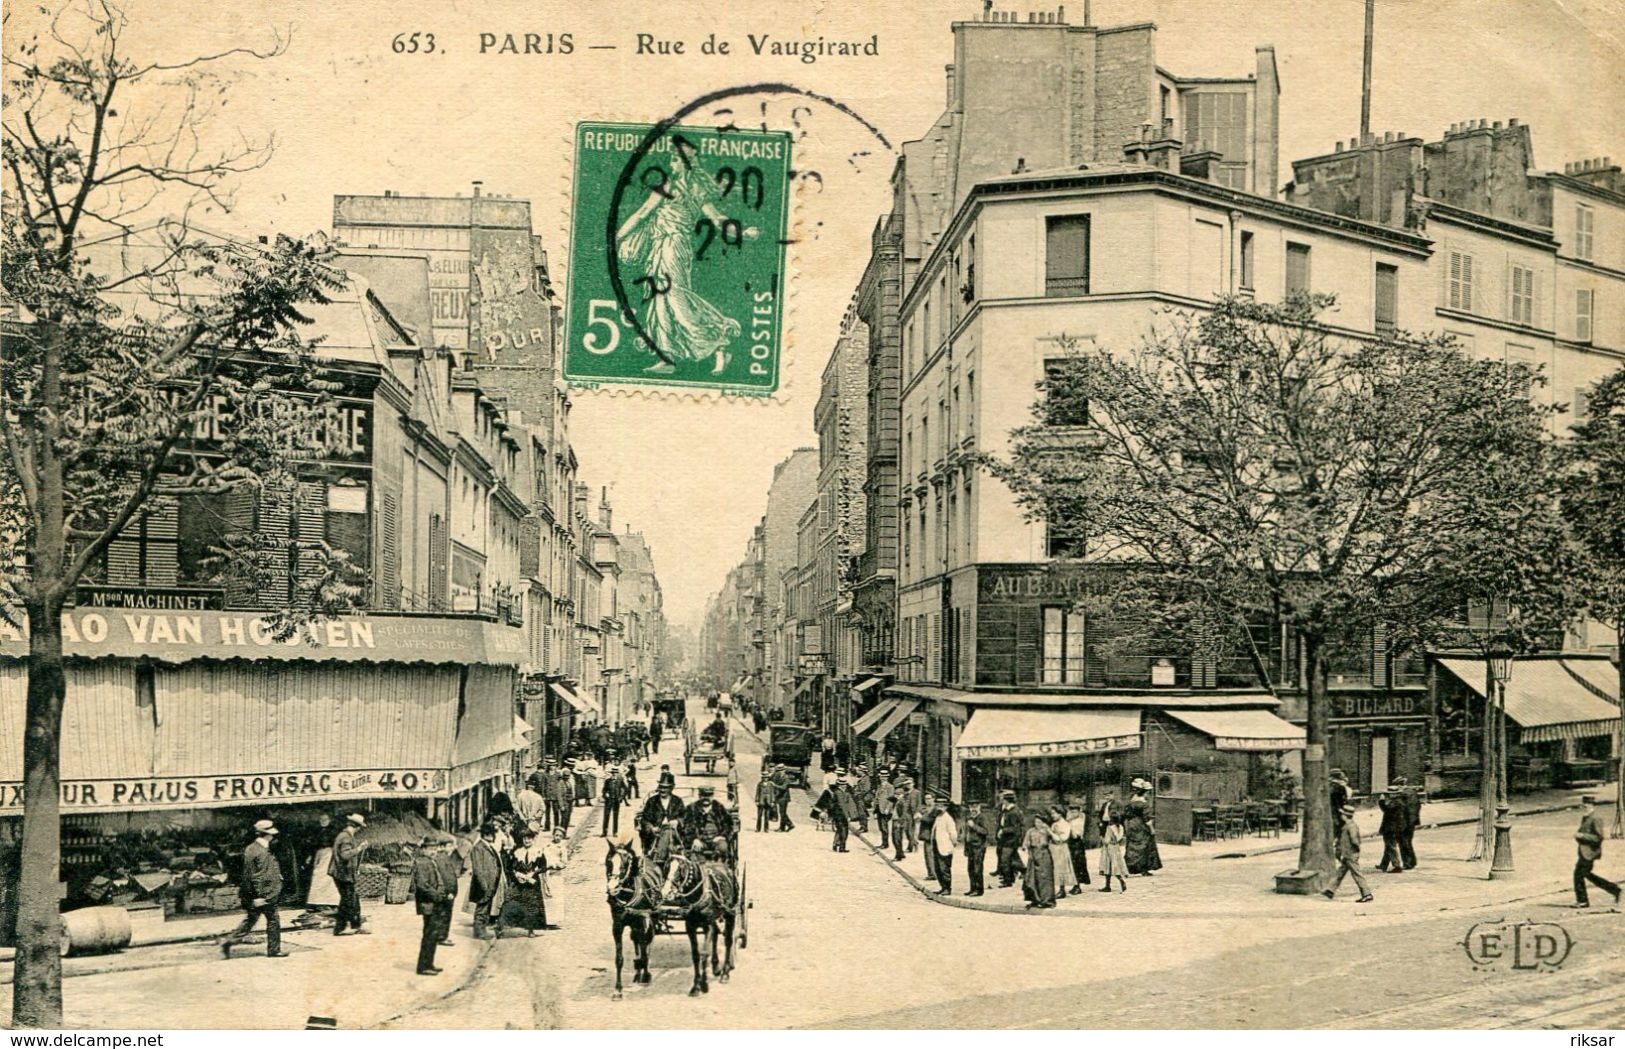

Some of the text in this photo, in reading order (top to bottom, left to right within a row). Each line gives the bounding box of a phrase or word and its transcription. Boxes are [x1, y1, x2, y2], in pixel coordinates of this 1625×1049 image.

[750, 290, 773, 375] POSTES
[123, 592, 208, 611] MACHINET
[123, 614, 203, 644] VAN
[1344, 697, 1414, 715] BILLARD
[113, 781, 198, 803] PALUS
[213, 774, 331, 799] FRONSAC
